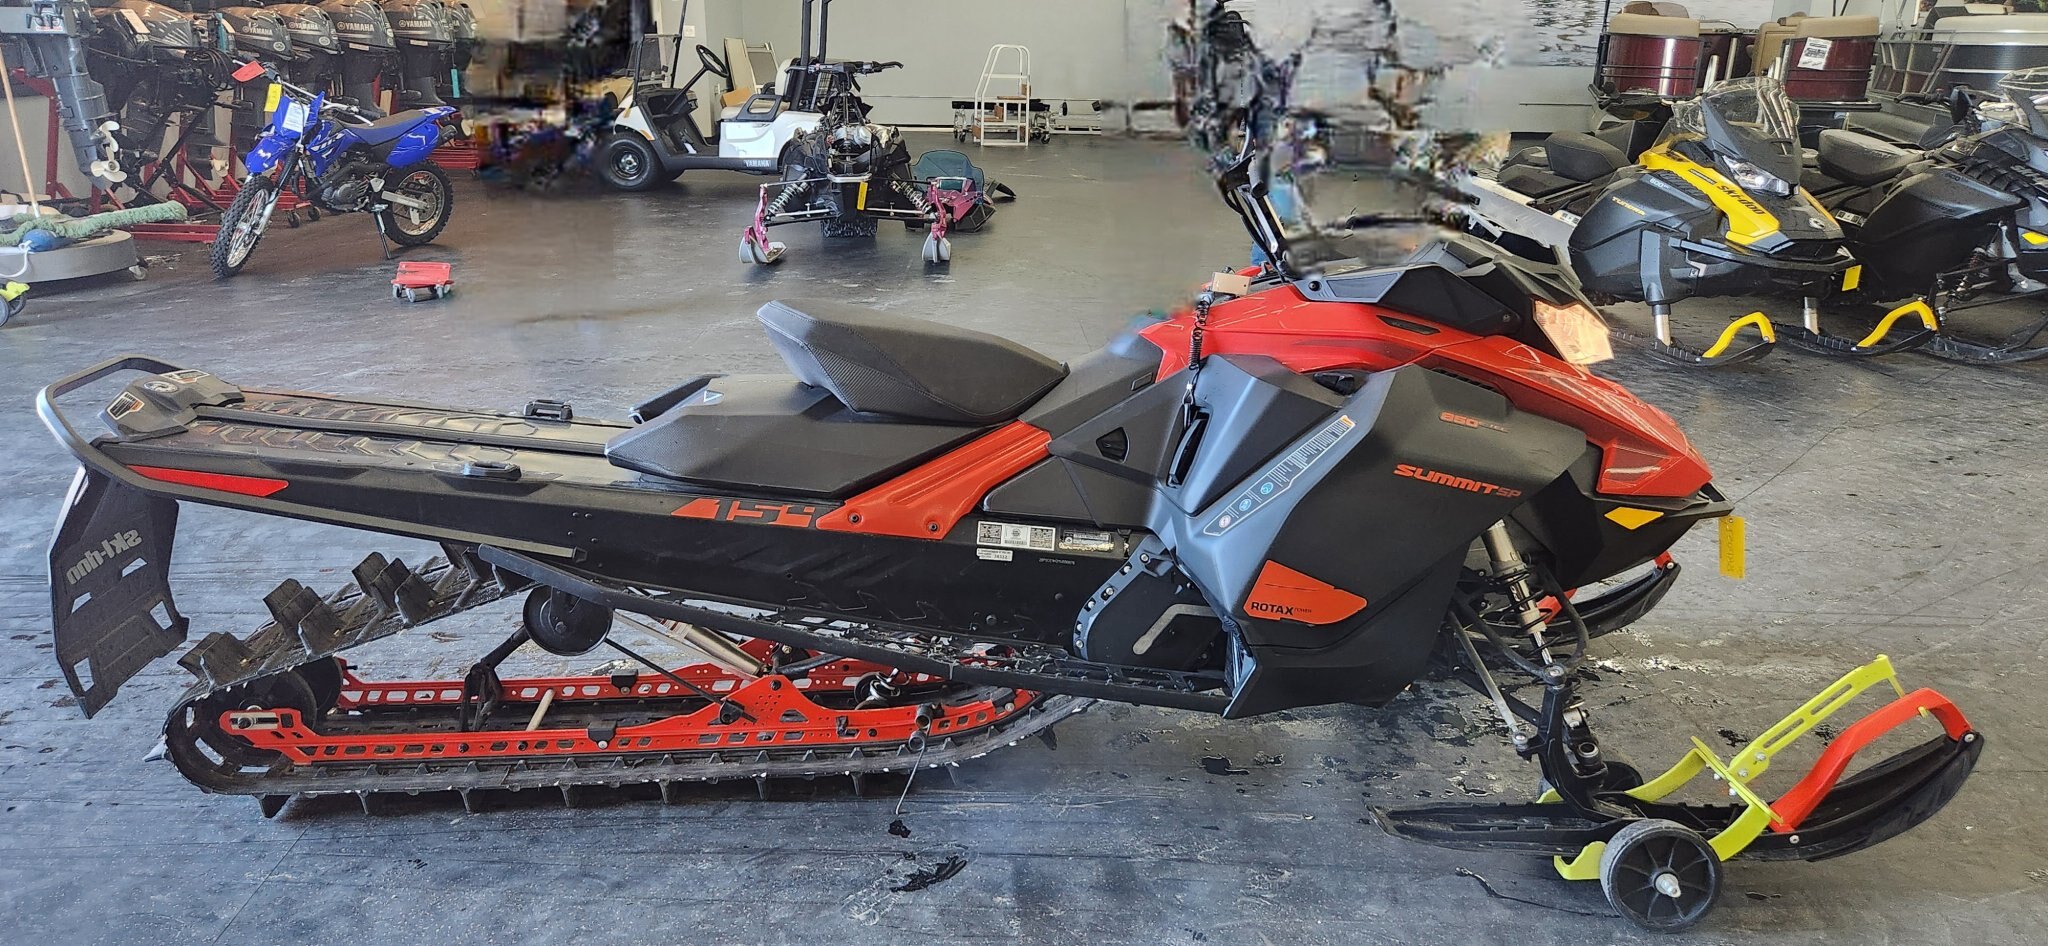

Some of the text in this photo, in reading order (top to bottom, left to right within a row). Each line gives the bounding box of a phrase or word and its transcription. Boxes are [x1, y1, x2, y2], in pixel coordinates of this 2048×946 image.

[294, 22, 319, 30] YAMAHA
[345, 22, 375, 32] YAMAHA
[406, 20, 432, 28] YAMAHA
[249, 28, 273, 36] YAMAHA
[745, 159, 771, 168] YAMAHA
[1717, 185, 1766, 215] ski-doo
[1392, 463, 1522, 498] SUMMIT SP
[1250, 601, 1294, 616] ROTAX
